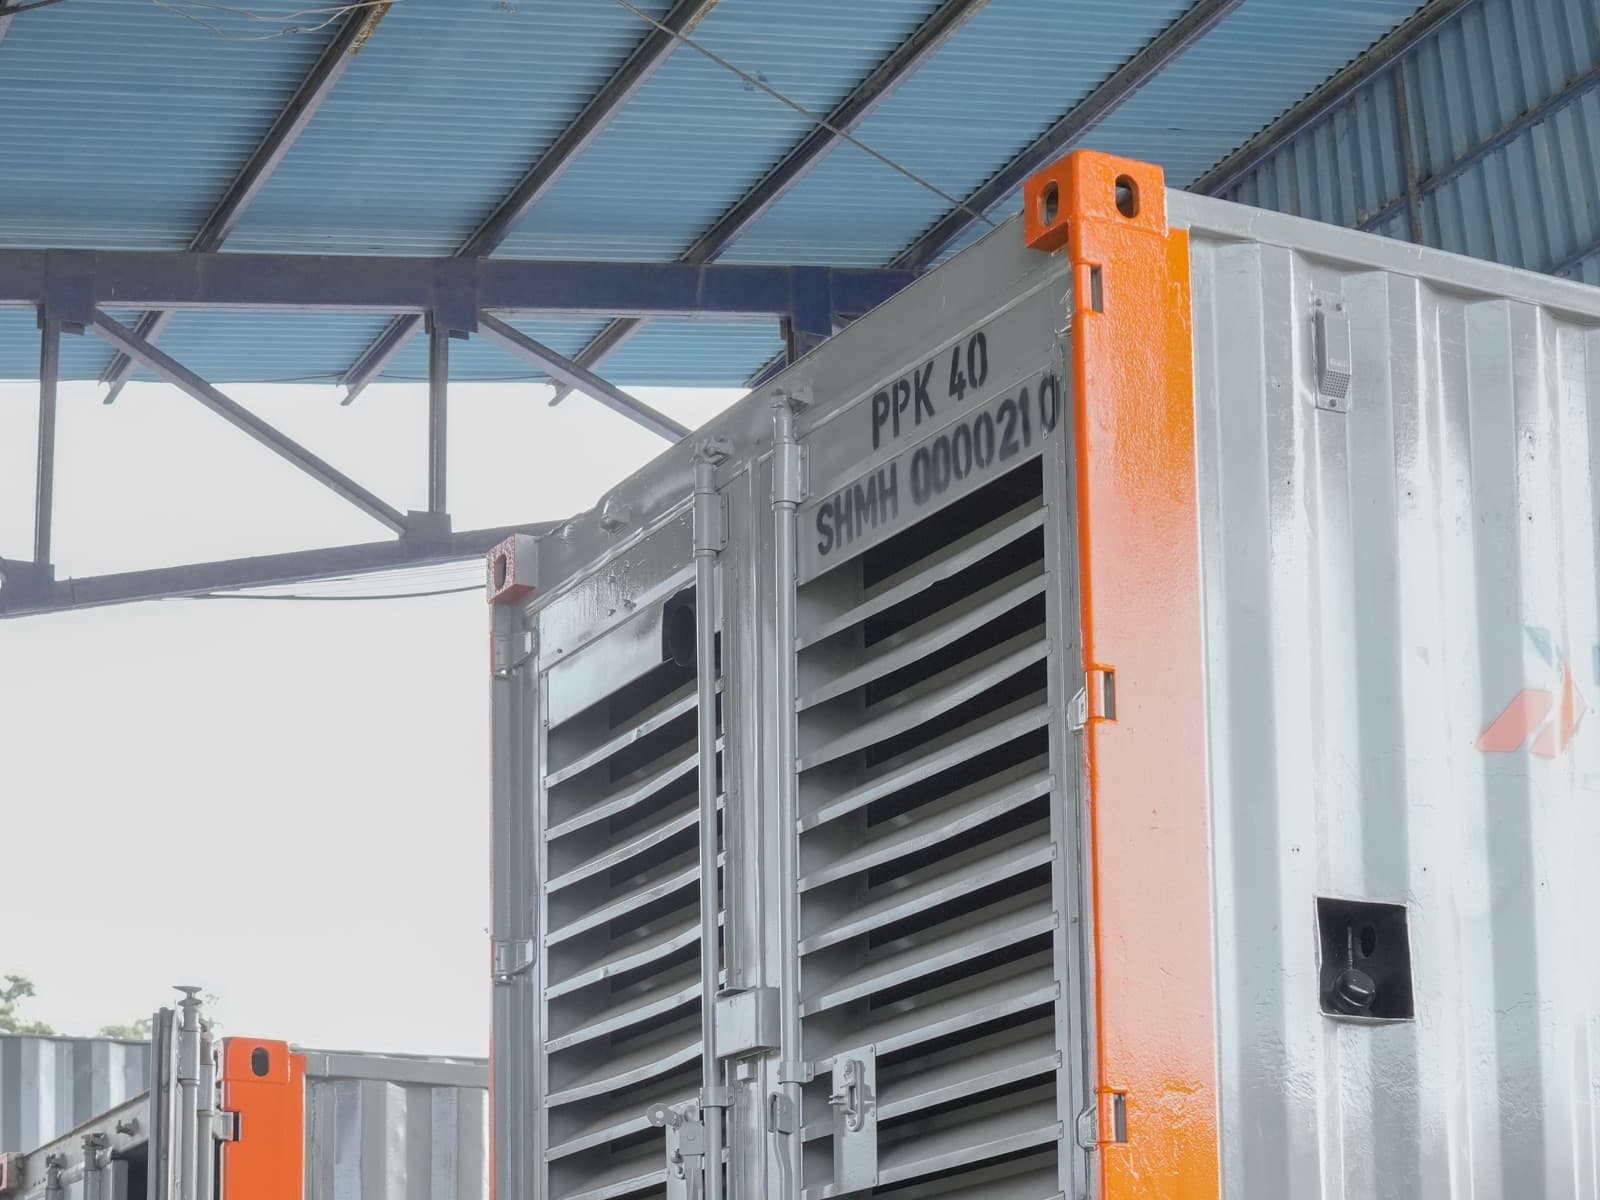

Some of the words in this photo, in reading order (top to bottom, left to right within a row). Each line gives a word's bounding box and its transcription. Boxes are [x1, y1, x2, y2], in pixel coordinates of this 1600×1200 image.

[871, 361, 935, 450] PPK
[949, 331, 988, 401] 40
[816, 463, 898, 556] SHMH
